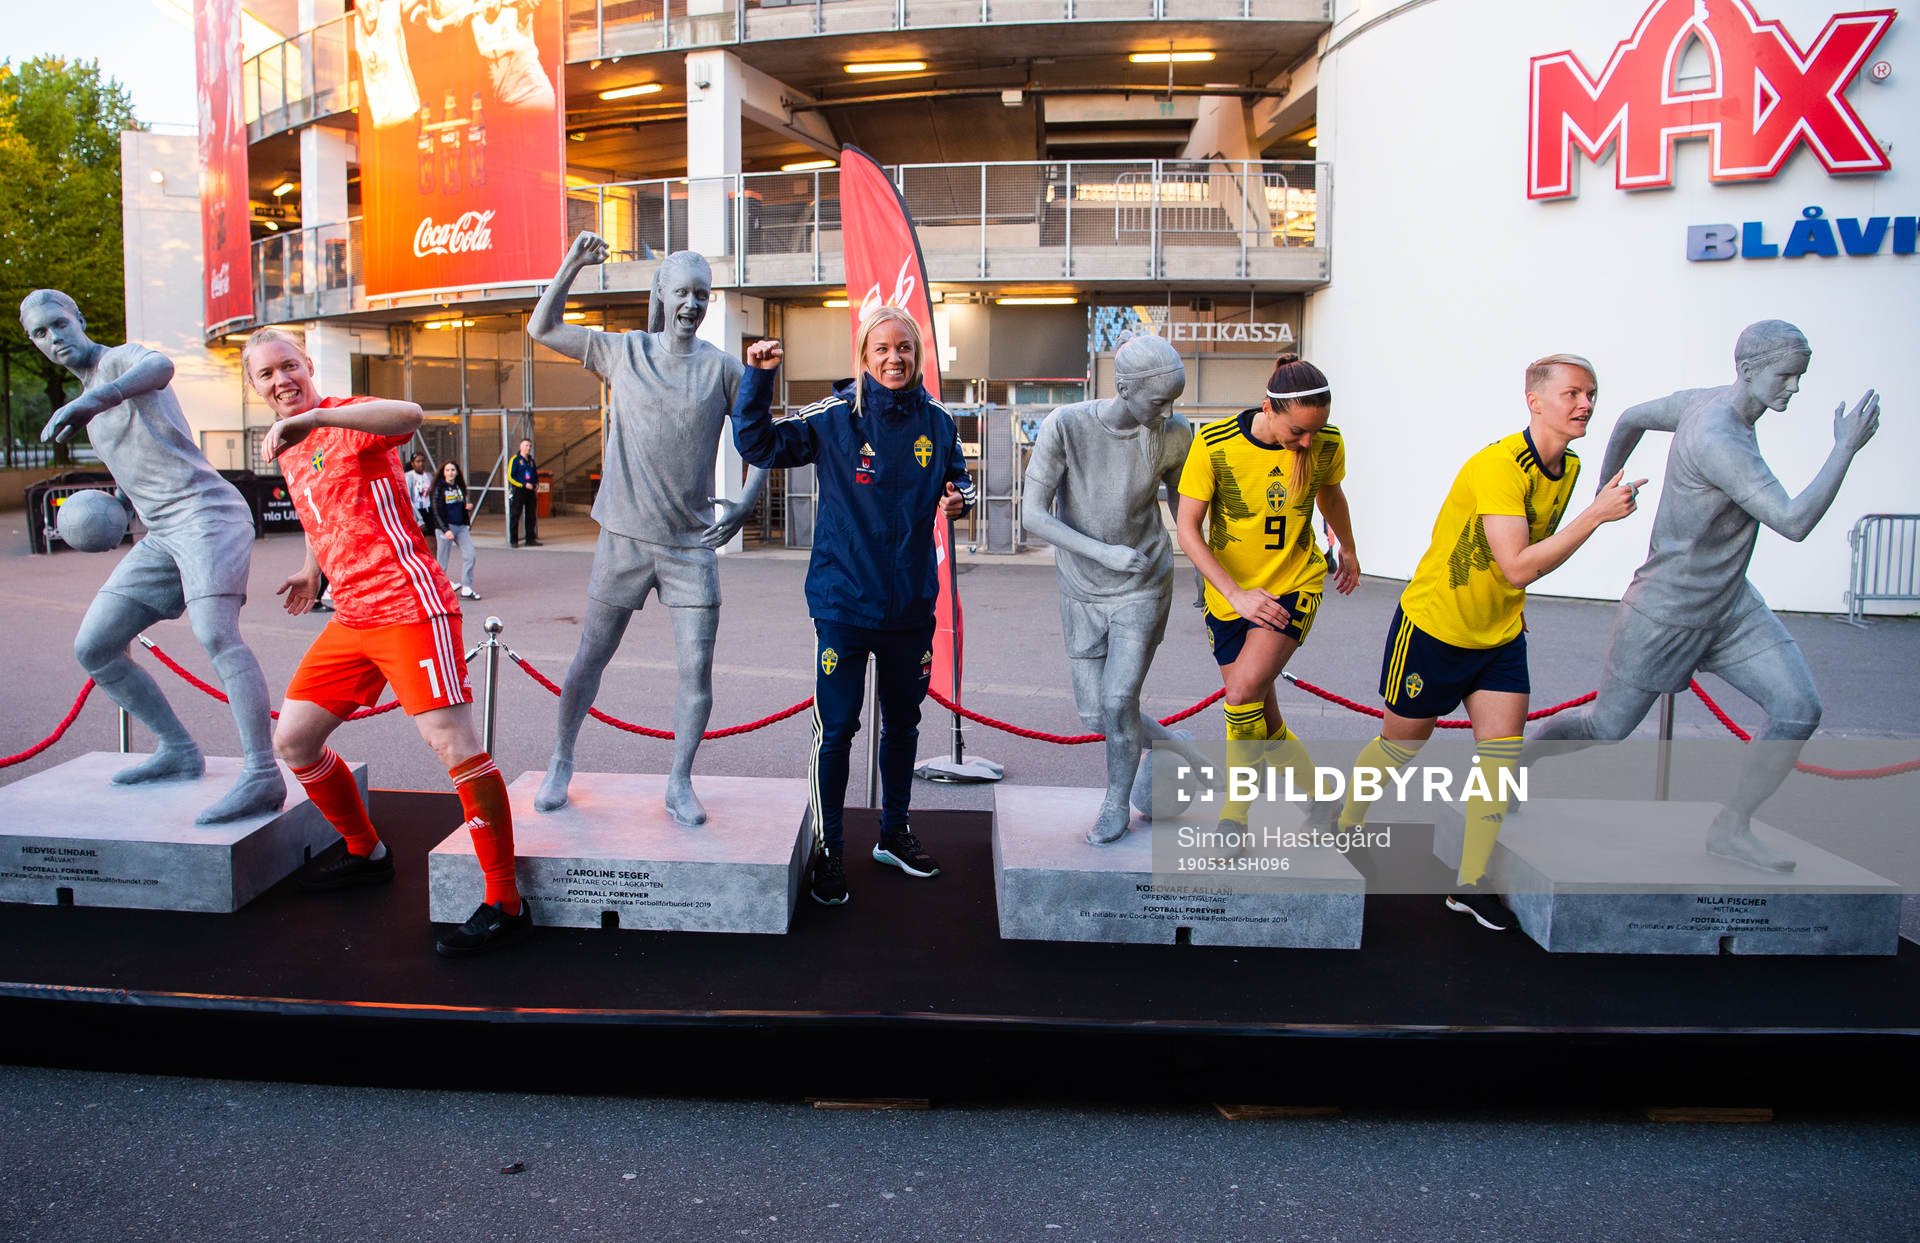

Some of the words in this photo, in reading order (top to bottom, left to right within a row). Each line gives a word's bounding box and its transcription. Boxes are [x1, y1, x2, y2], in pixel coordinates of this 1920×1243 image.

[1527, 0, 1898, 200] MAX
[413, 210, 496, 258] Coca-Cola
[1687, 206, 1920, 262] BLÅVI
[304, 487, 322, 525] 1
[1264, 515, 1287, 550] 9
[1291, 591, 1314, 629] 9
[419, 658, 441, 699] 1
[21, 846, 56, 855] HEDVIG
[58, 848, 98, 857] LINDAHL
[566, 869, 616, 878] CAROLINE
[618, 871, 650, 880] SEGER
[619, 881, 664, 889] LAGKAPTEN
[1135, 884, 1189, 893] KOSOVARE
[1191, 886, 1233, 896] ASLLANI
[554, 896, 590, 904] Coca-Cola
[567, 889, 607, 897] FOOTBALL
[609, 891, 649, 899] FOREVHER
[1697, 897, 1725, 905] NILLA
[1727, 898, 1767, 907] FISCHER
[1185, 907, 1226, 915] FOREVHER
